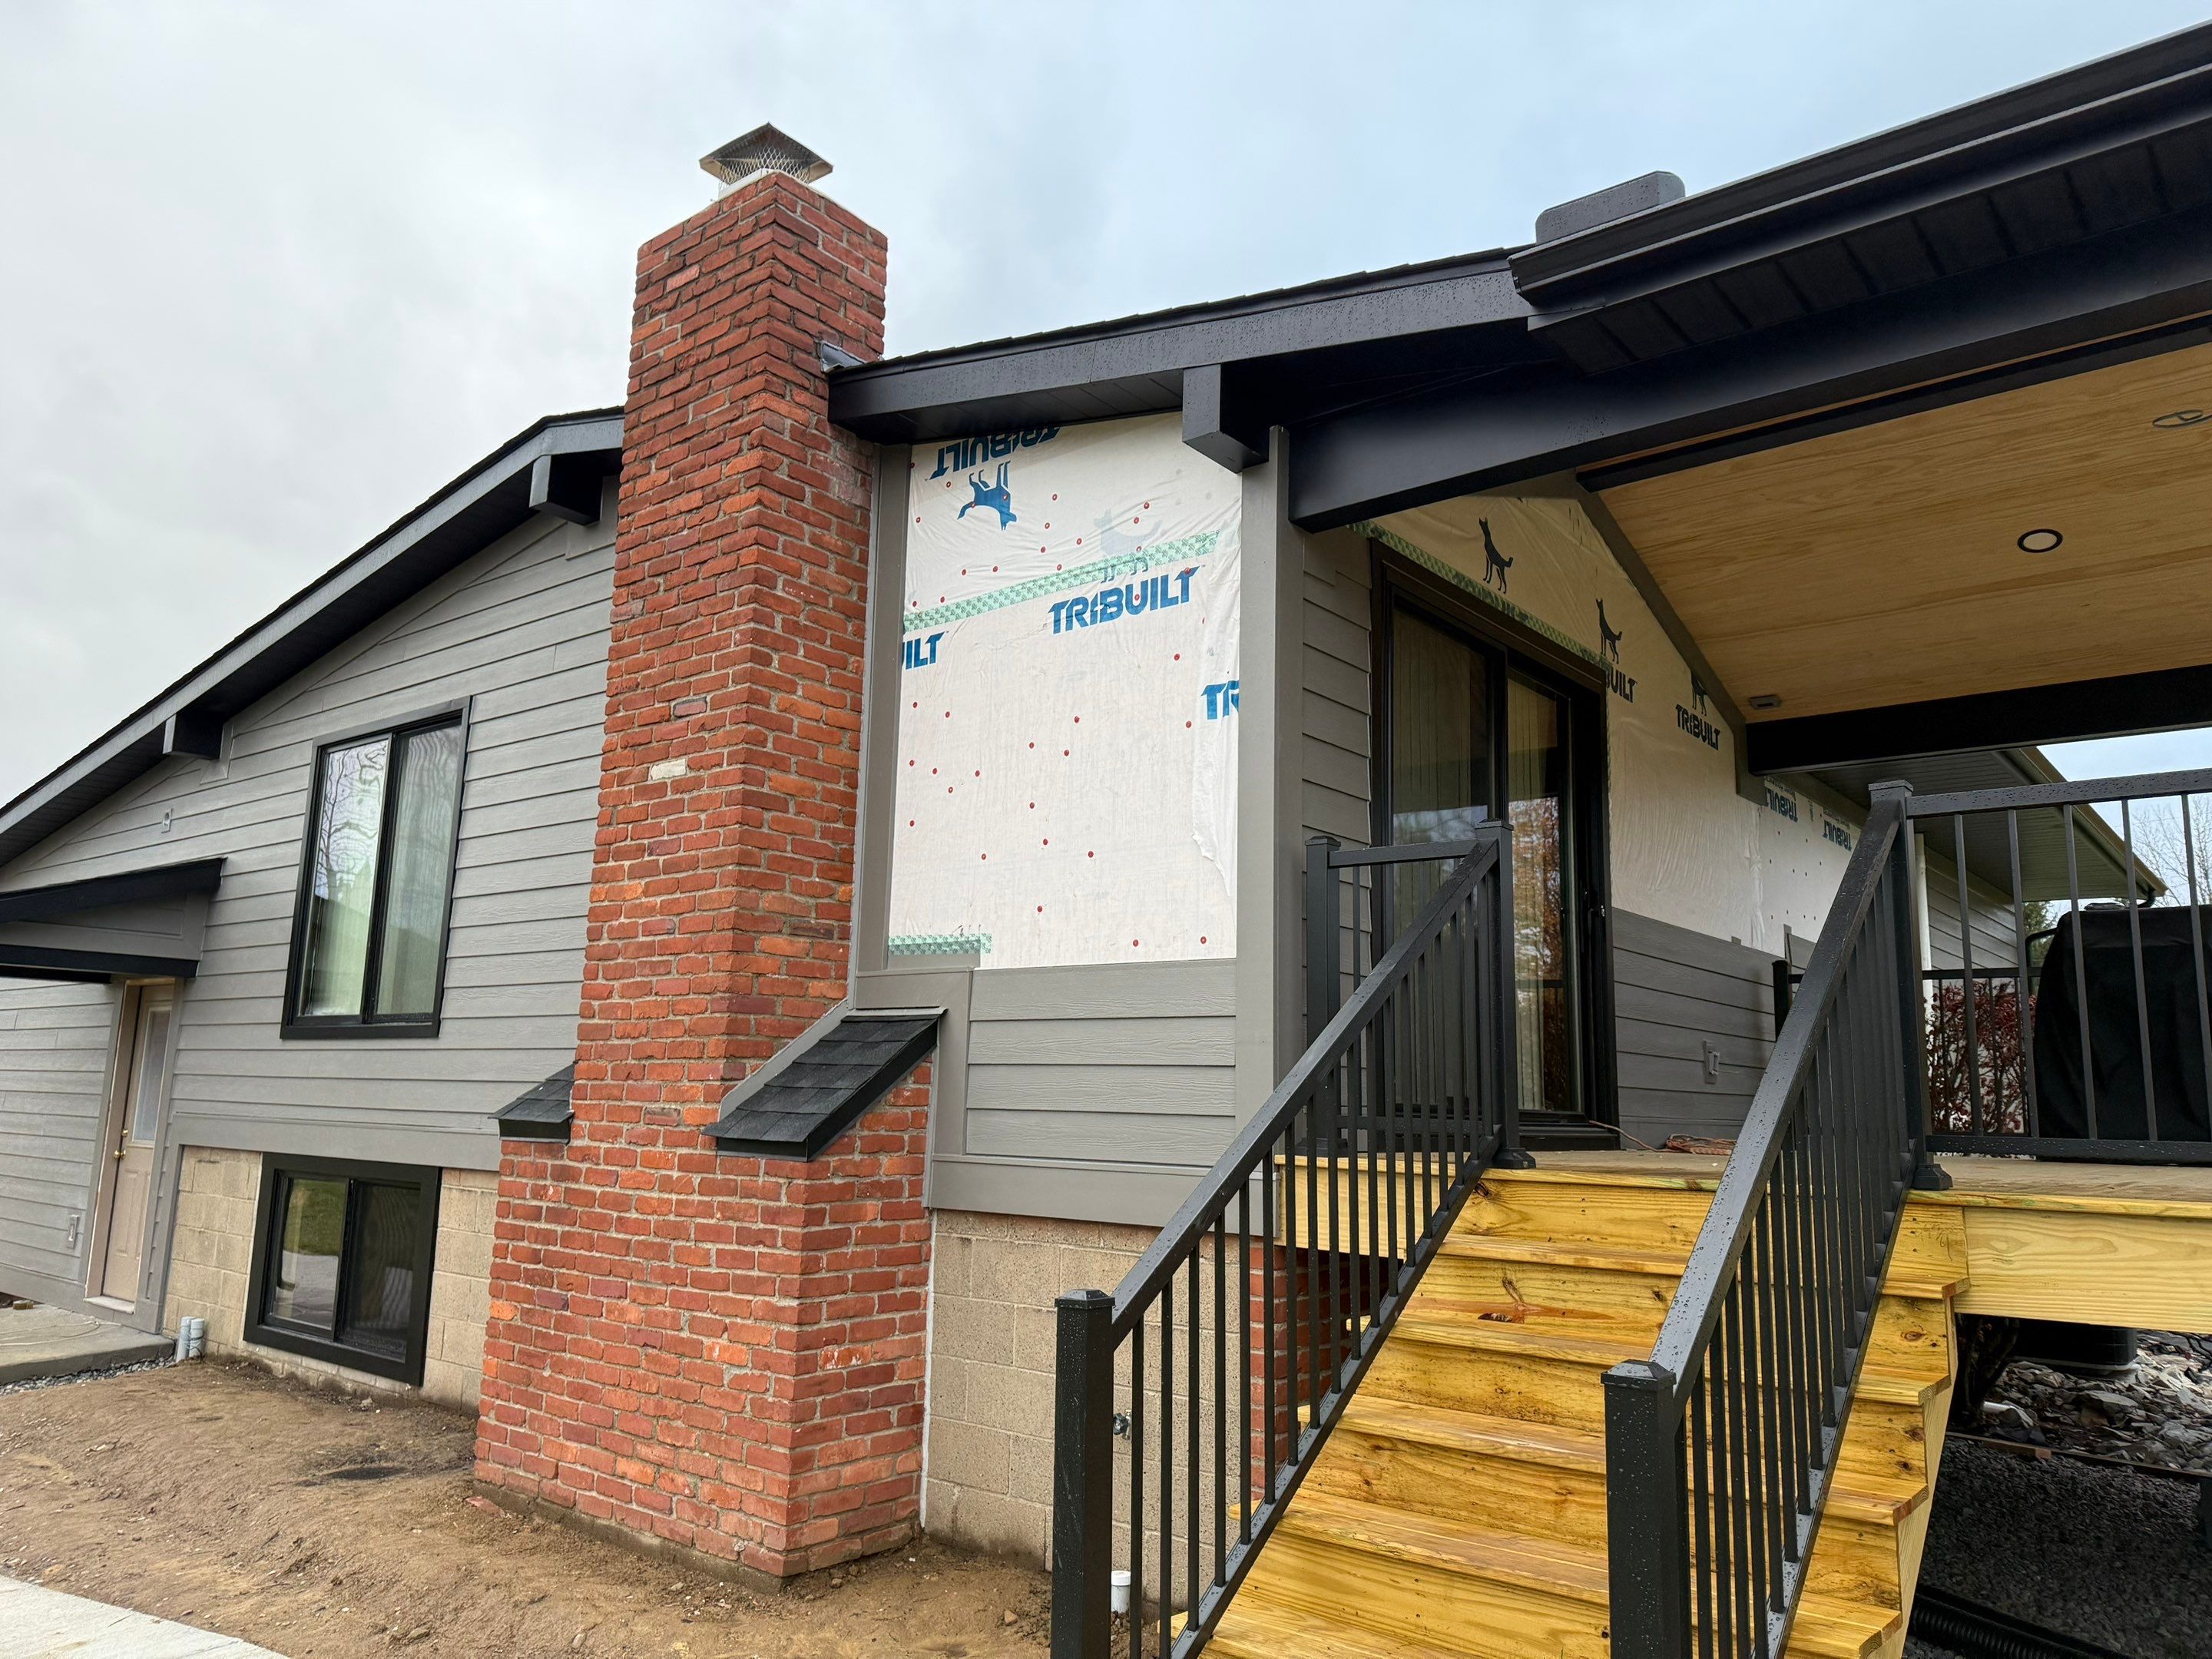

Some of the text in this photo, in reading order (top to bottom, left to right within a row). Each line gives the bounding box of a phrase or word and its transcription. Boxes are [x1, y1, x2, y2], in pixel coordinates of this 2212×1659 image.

[1048, 565, 1200, 635] TRIBUILT
[902, 631, 945, 670] ILT
[1606, 667, 1637, 704] UILT
[1675, 704, 1720, 751] TRIBUILT
[1822, 820, 1852, 852] TRIBUILT
